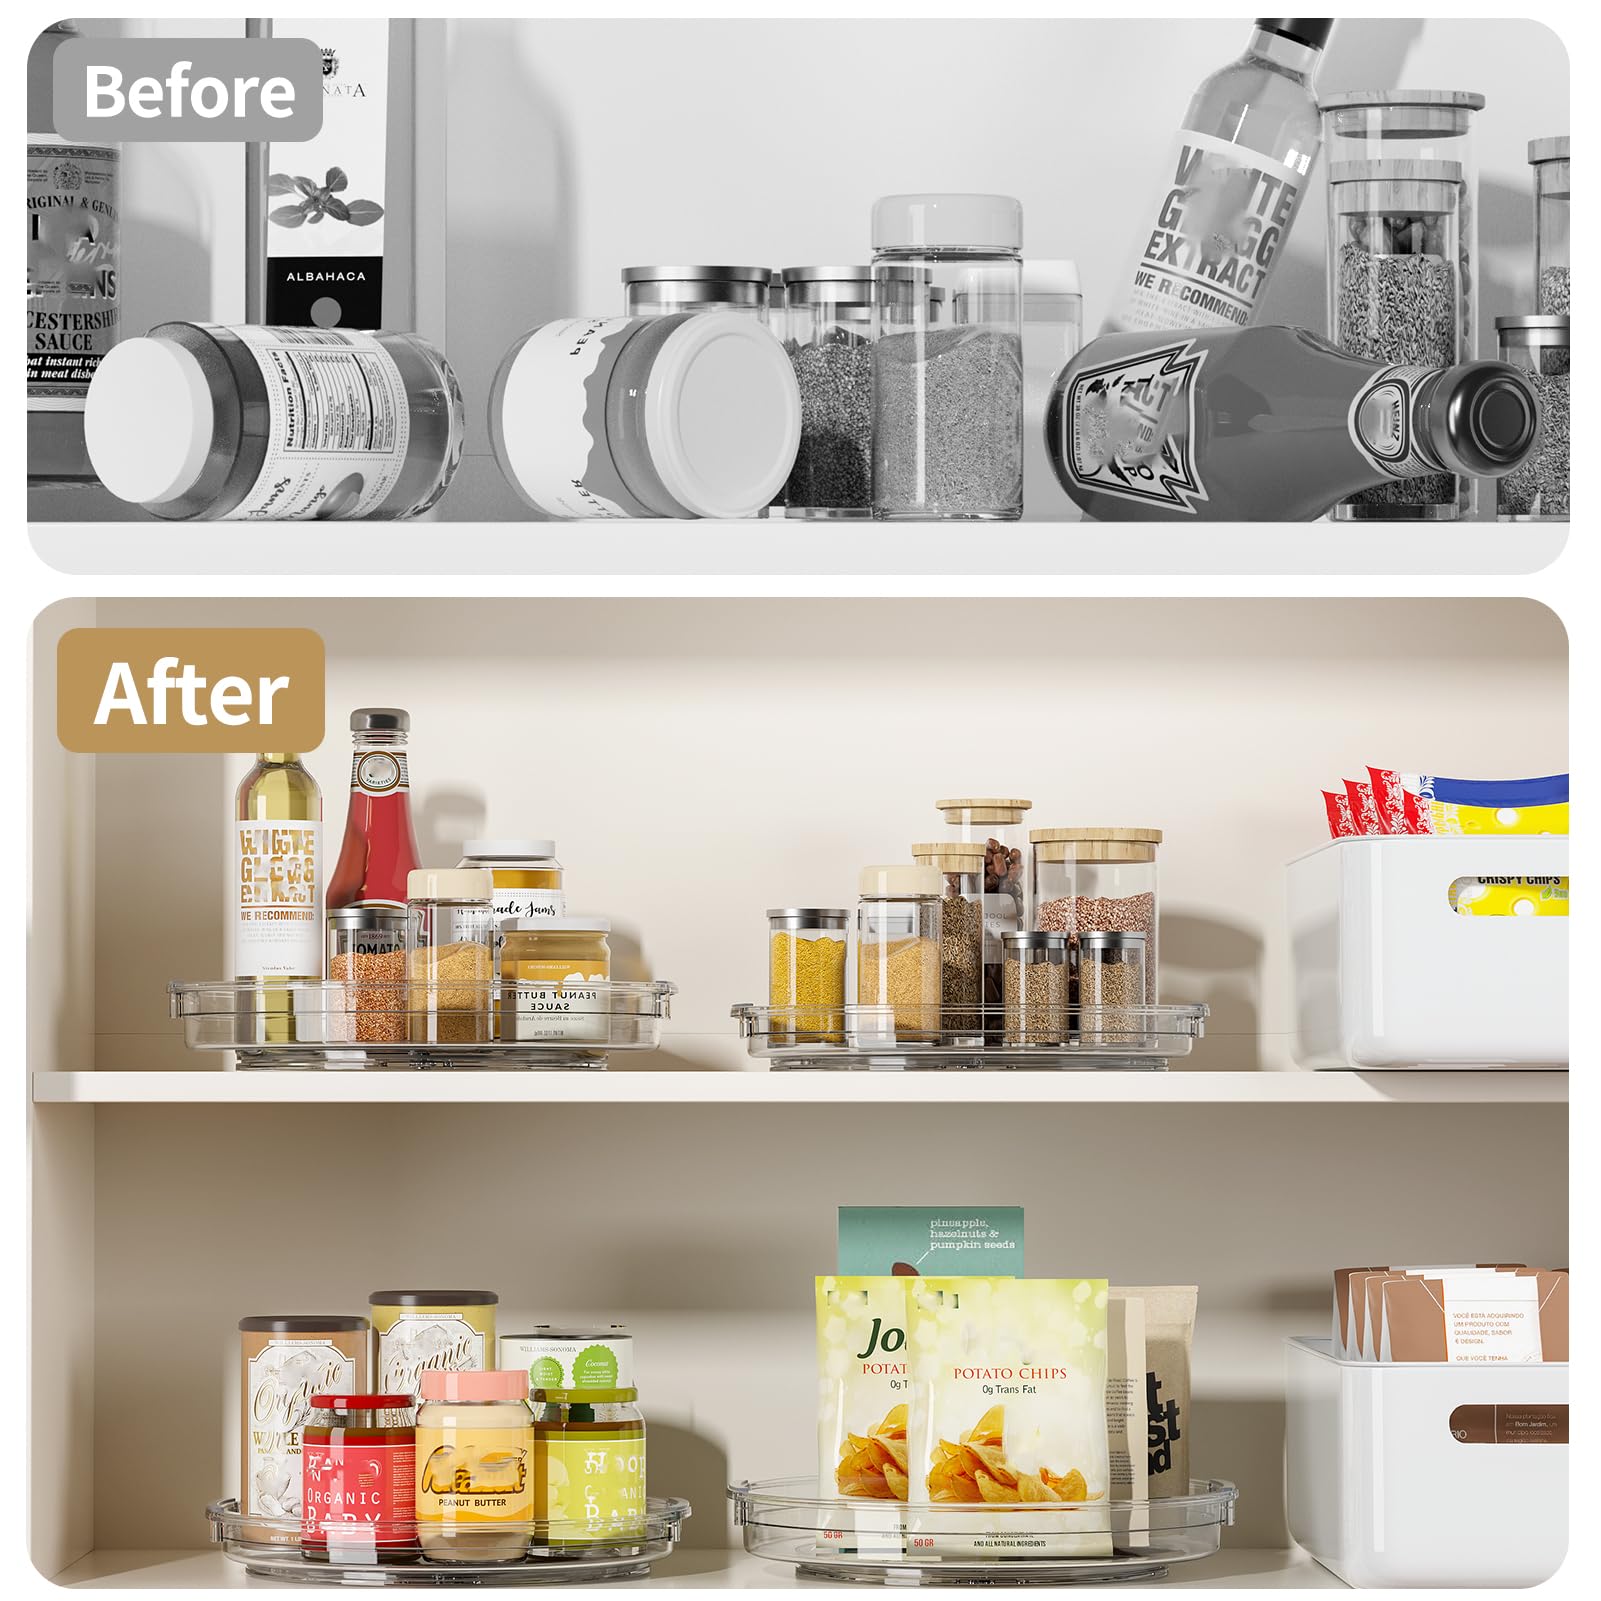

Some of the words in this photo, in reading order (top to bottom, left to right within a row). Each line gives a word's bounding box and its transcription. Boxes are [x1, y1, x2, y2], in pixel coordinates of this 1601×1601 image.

[80, 196, 88, 209] &
[286, 271, 366, 282] ALBAHACA
[1134, 270, 1156, 289] WE
[35, 333, 93, 351] SAUCE
[45, 356, 80, 367] instant
[271, 351, 289, 384] Facts
[41, 368, 69, 379] meat
[286, 387, 295, 447] Nutrition
[366, 777, 392, 785] VARIETIES
[525, 900, 557, 918] Jams
[240, 911, 252, 921] WE
[254, 910, 315, 921] RECOMMEND:
[930, 1218, 990, 1229] pineapple,
[930, 1229, 987, 1238] hazelnuts
[988, 1229, 1000, 1238] &
[930, 1240, 982, 1251] pumpkin
[983, 1240, 1016, 1249] seeds
[519, 1345, 577, 1353] WILLIAMS-SONOMA
[953, 1368, 1014, 1379] POTATO
[1018, 1367, 1068, 1379] CHIPS
[982, 1384, 994, 1395] 0g
[995, 1384, 1020, 1394] Trans
[1022, 1384, 1037, 1394] Fat
[307, 1487, 381, 1505] ORGANIC
[438, 1498, 470, 1507] PEANUT
[474, 1498, 507, 1507] BUTTER
[823, 1530, 834, 1539] 50
[834, 1530, 843, 1539] GR
[914, 1538, 924, 1547] 50
[924, 1538, 934, 1547] GR
